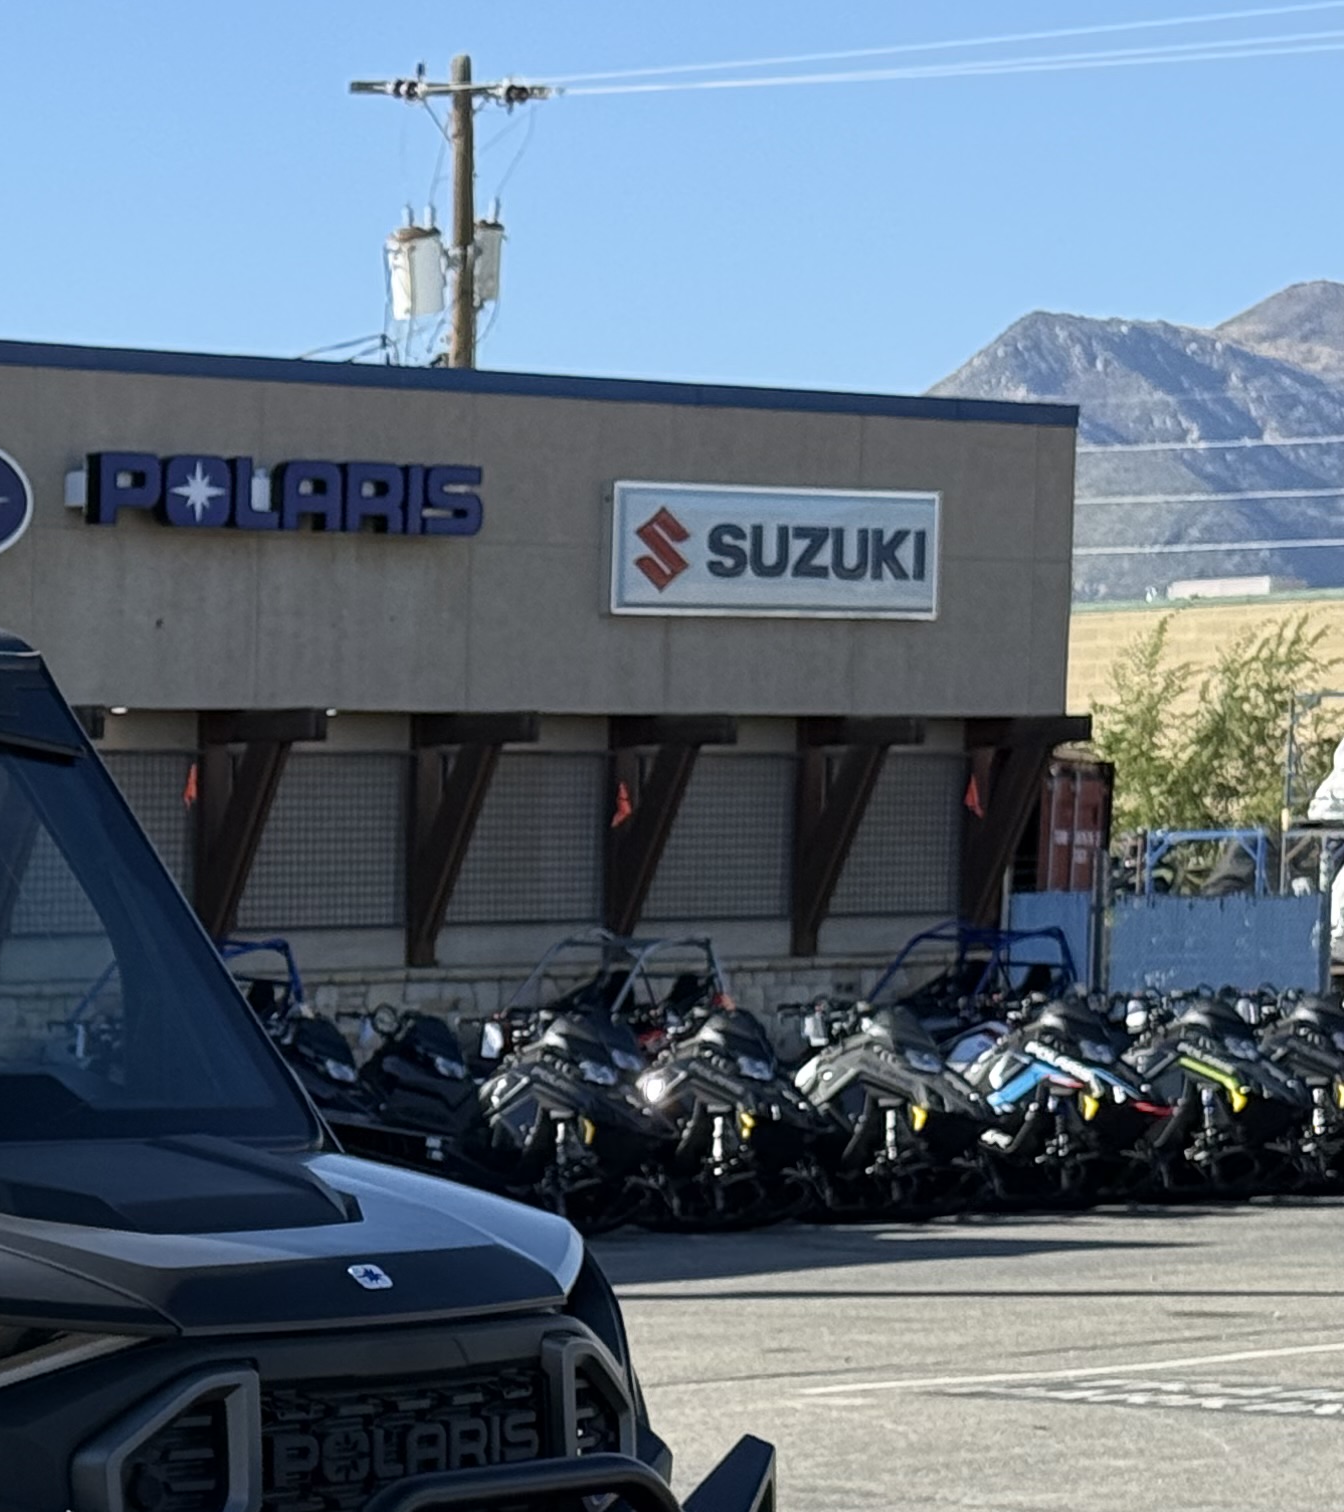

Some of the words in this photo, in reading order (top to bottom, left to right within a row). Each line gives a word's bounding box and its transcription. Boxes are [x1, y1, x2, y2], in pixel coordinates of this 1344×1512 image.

[88, 452, 483, 536] POLARIS
[707, 523, 926, 581] SUZUKI
[272, 1408, 539, 1488] POLARIS
